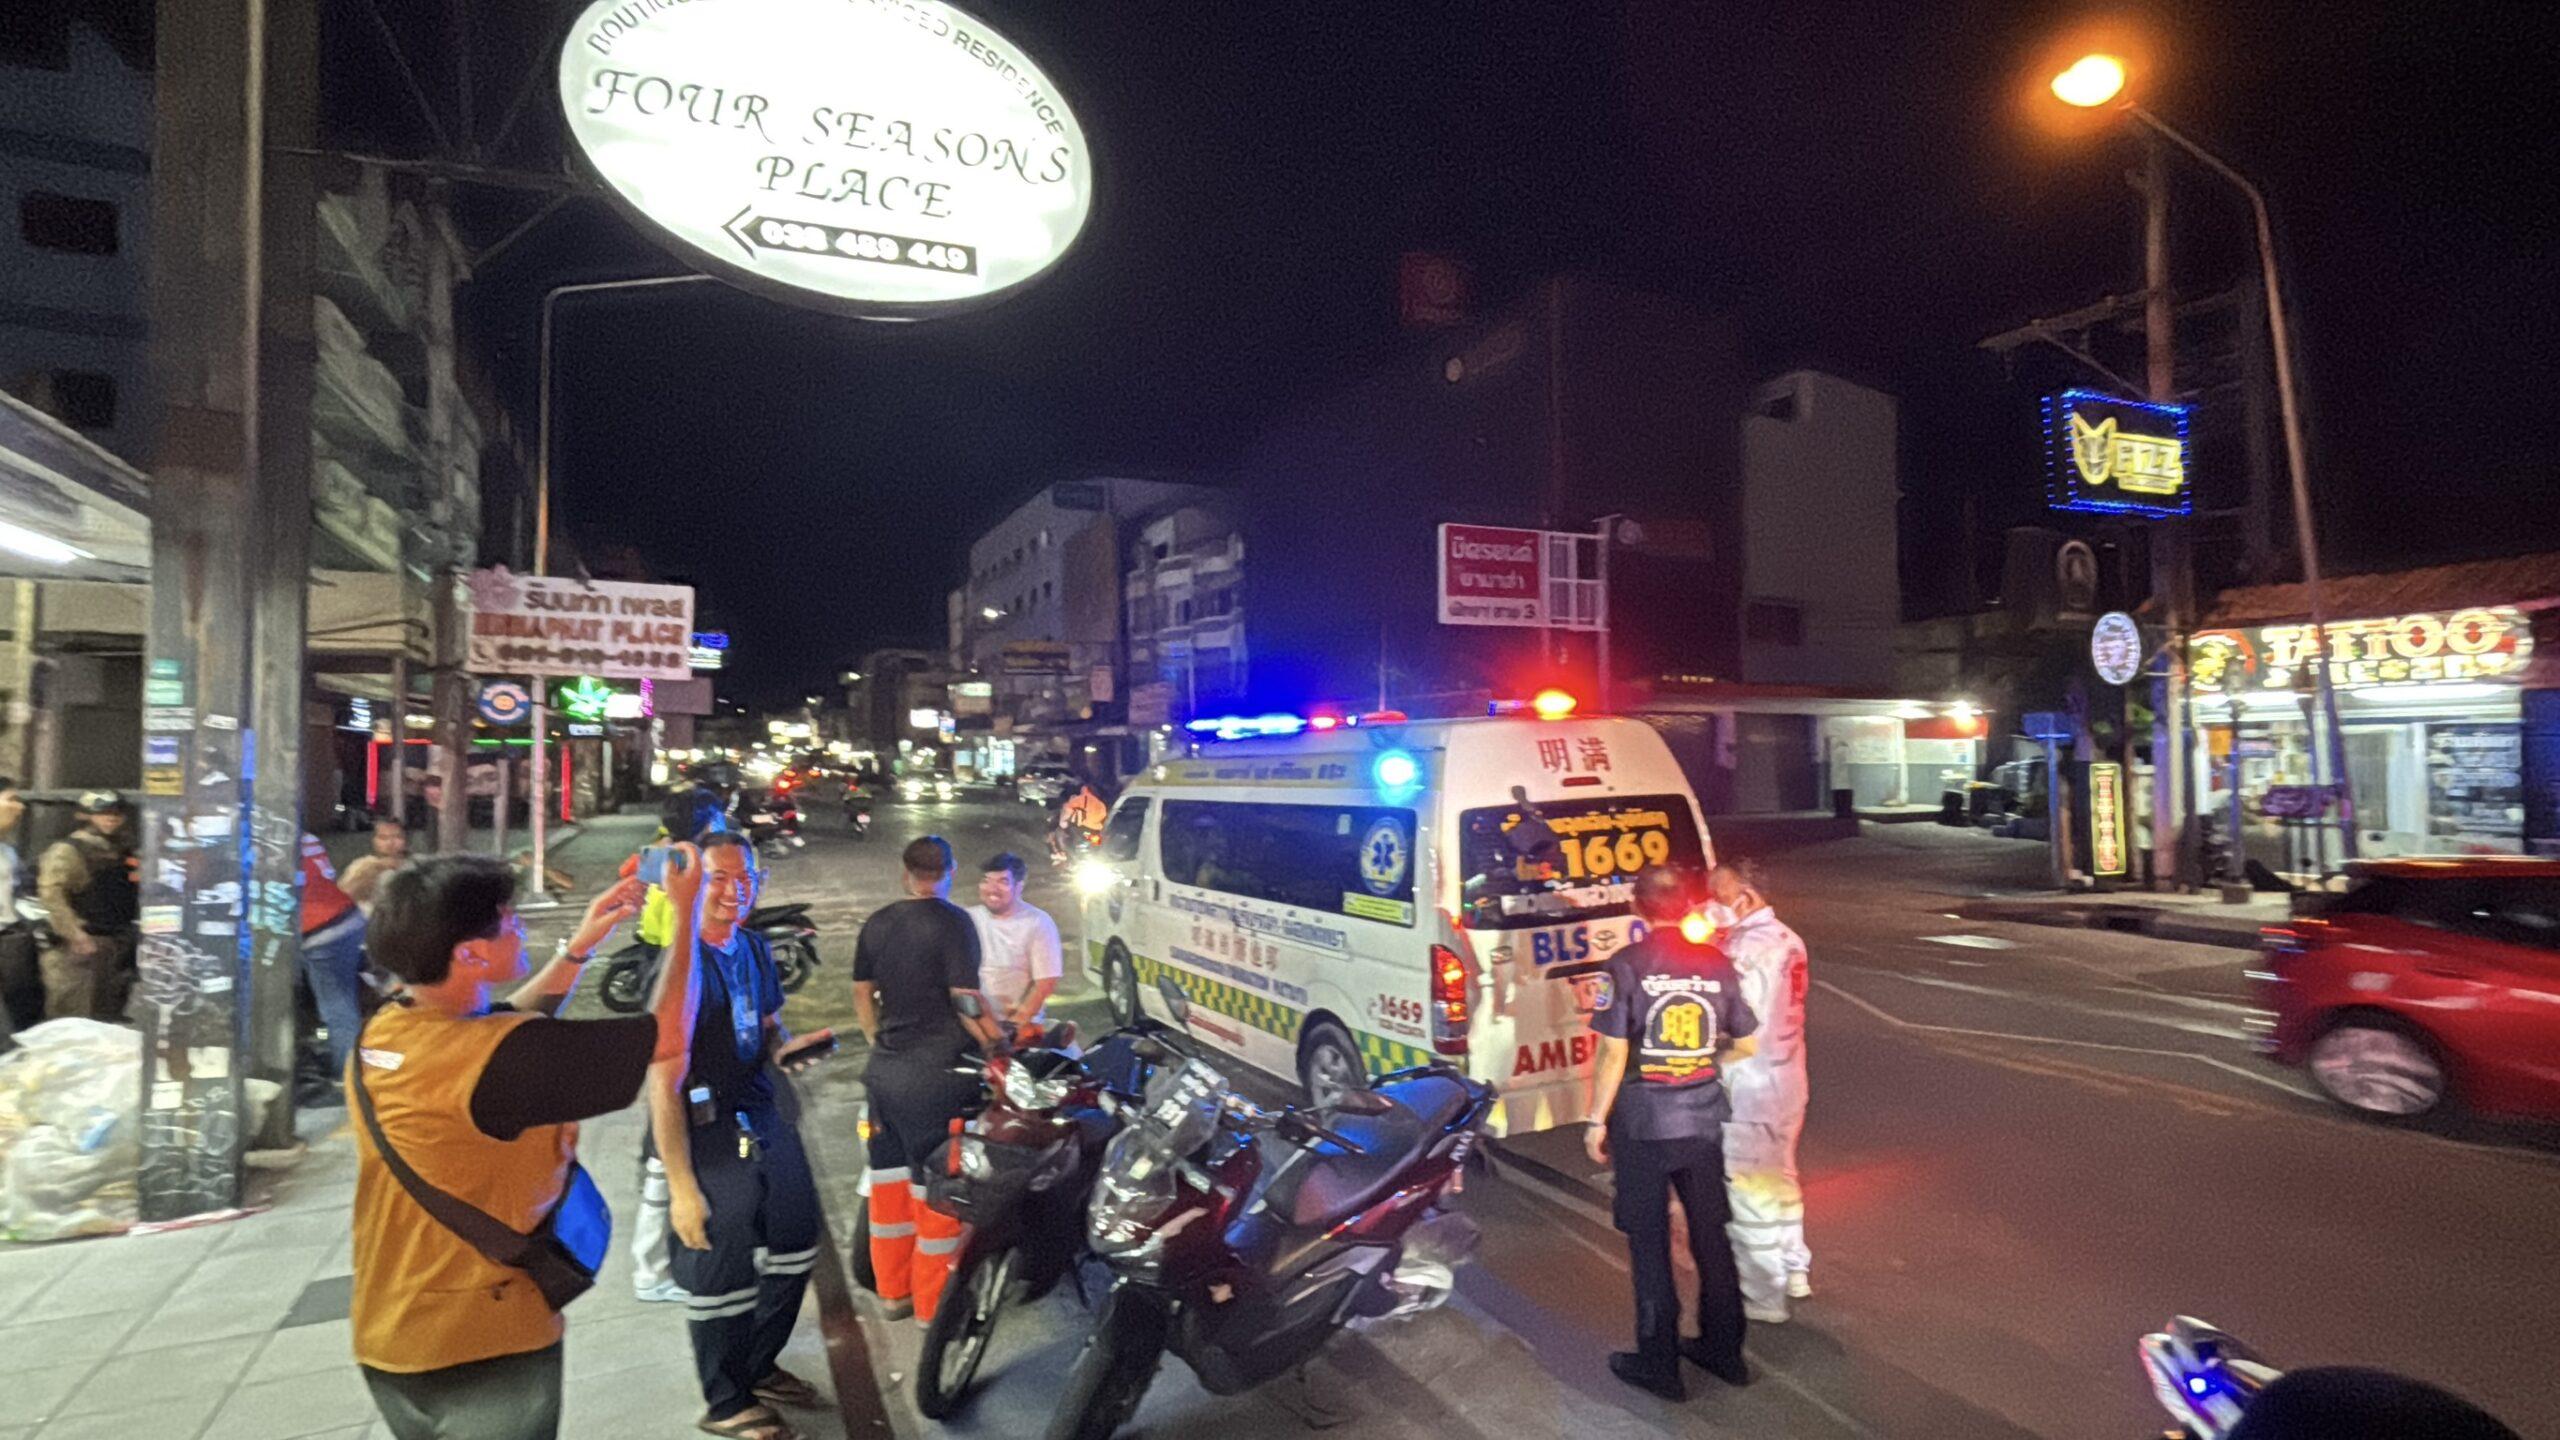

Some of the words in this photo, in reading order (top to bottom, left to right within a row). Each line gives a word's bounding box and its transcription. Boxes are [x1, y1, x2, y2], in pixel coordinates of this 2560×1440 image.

[953, 29, 1065, 135] RESIDENCE
[586, 68, 775, 144] FOUR
[802, 106, 1070, 185] SEASONS
[755, 155, 952, 218] PLACE
[907, 241, 969, 271] 449
[1523, 603, 1537, 620] 3
[1560, 830, 1670, 878] 1669
[1531, 926, 1591, 966] BLS
[1378, 993, 1424, 1024] 1669
